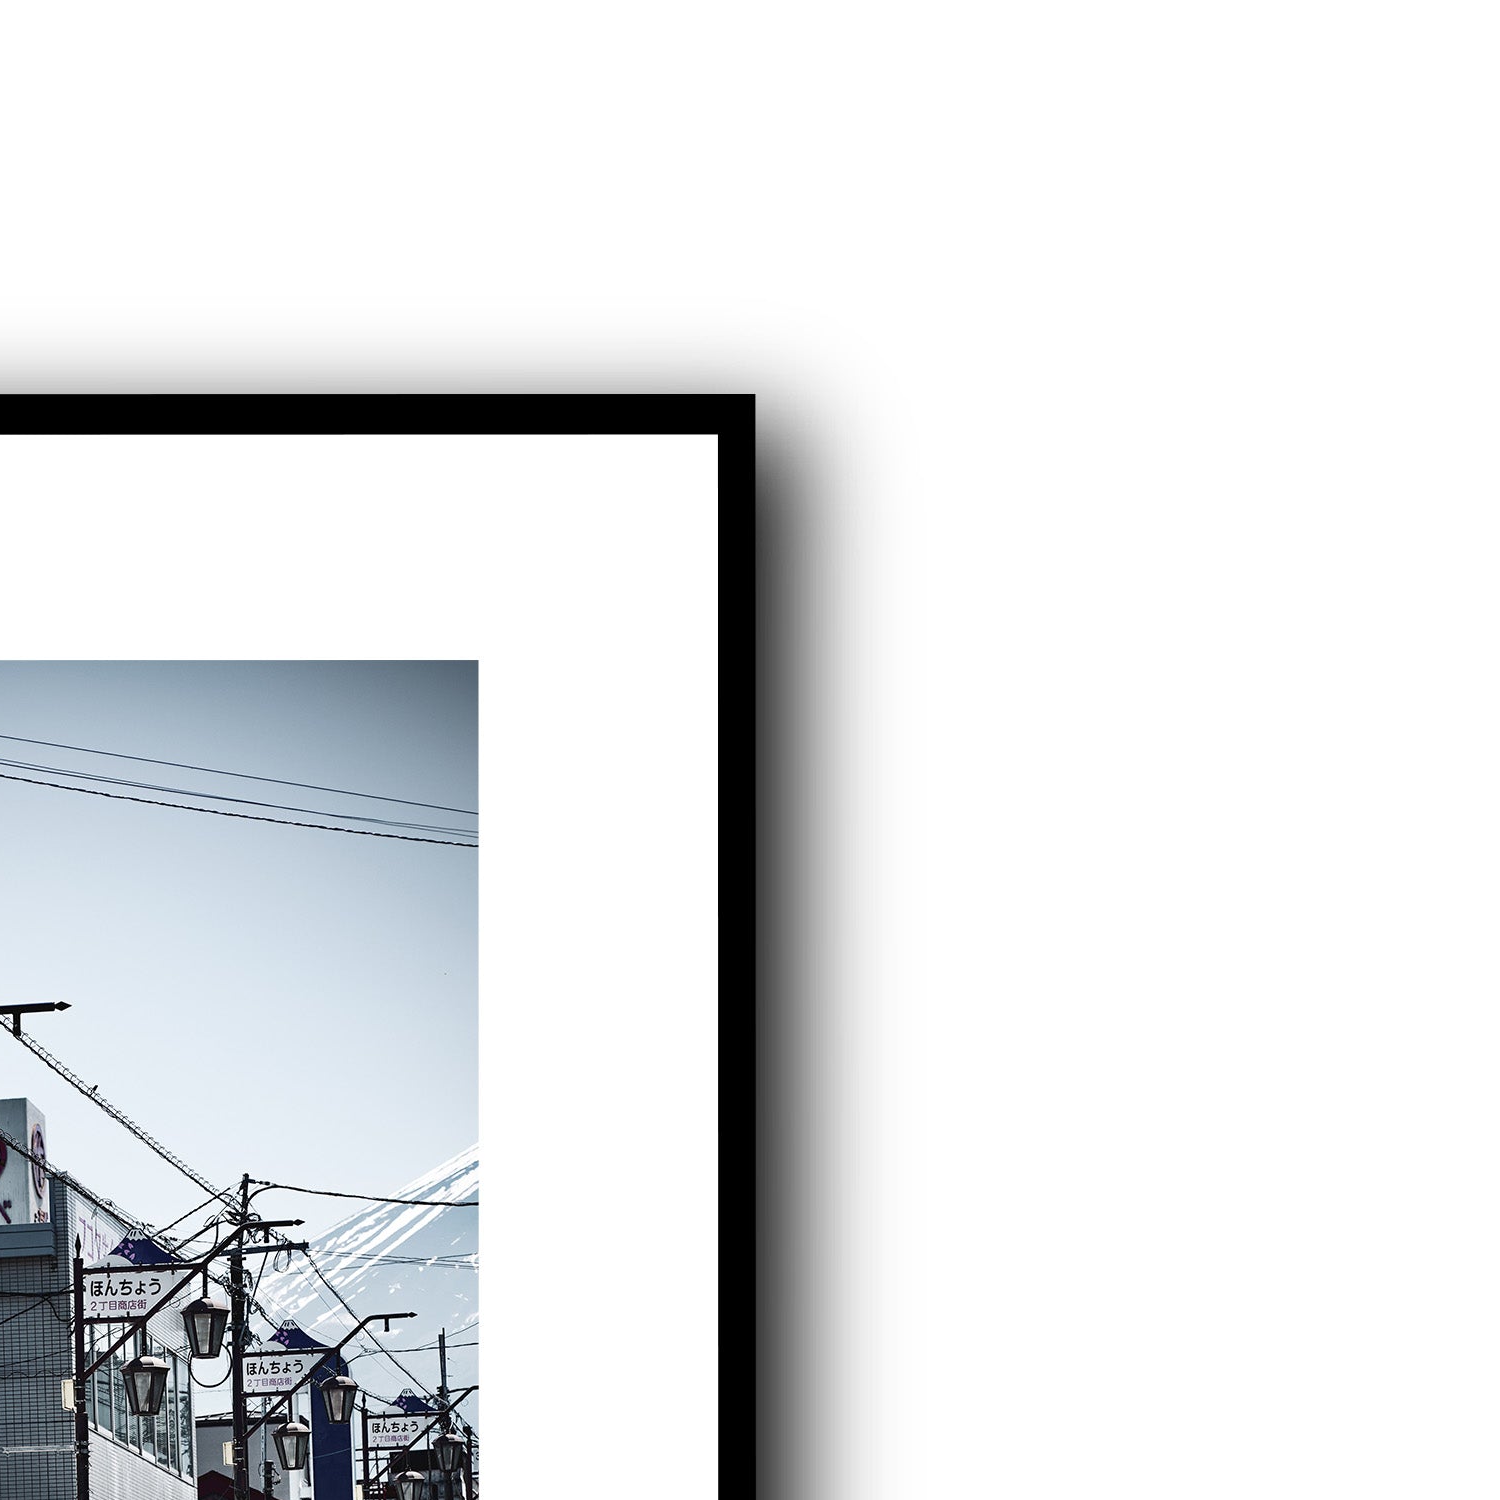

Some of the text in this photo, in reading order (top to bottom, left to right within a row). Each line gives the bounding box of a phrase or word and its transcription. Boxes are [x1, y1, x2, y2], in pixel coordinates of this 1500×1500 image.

[90, 1277, 162, 1297] ほんちょう
[246, 1359, 304, 1376] ほんちょう
[371, 1420, 419, 1434] ほんちょう
